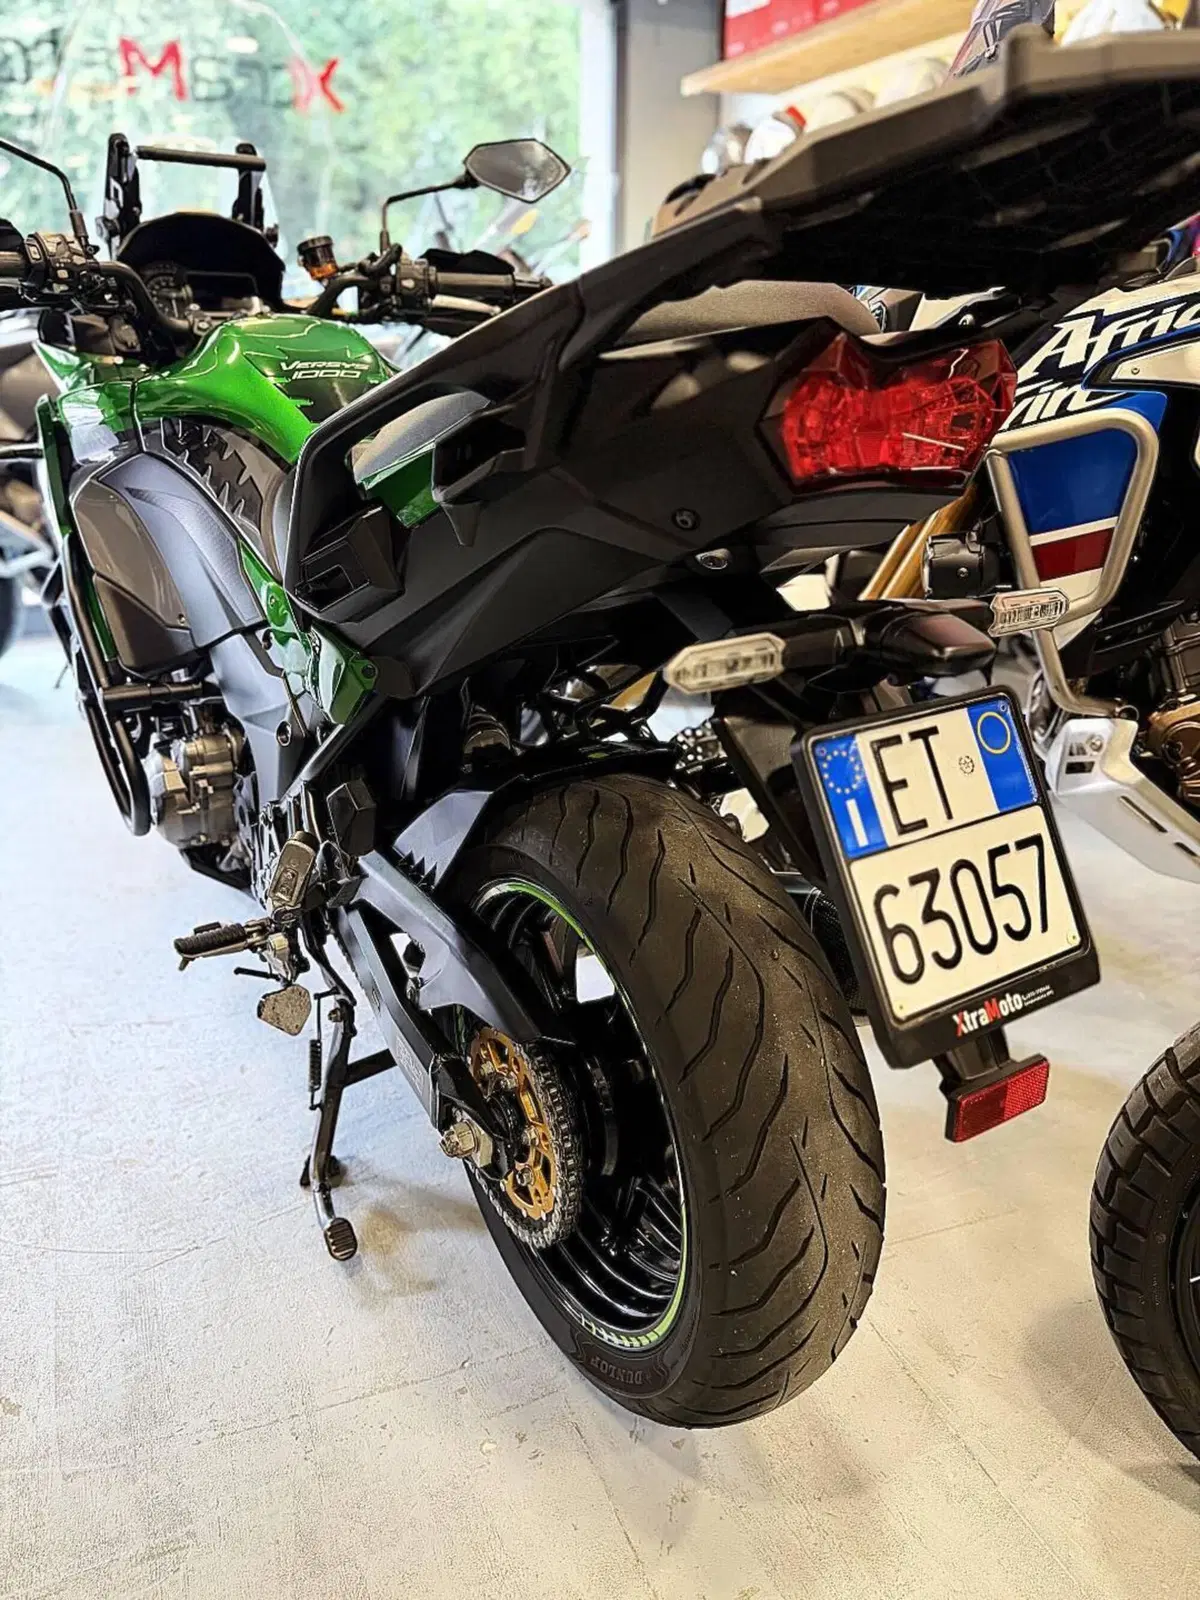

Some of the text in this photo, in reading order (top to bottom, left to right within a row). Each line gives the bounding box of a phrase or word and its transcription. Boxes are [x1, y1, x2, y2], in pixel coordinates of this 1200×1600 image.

[292, 369, 361, 379] 1000
[869, 725, 953, 836] ET
[873, 832, 1048, 985] 63057
[952, 993, 1024, 1037] XtraMoto
[591, 1356, 643, 1385] DUNLOP
